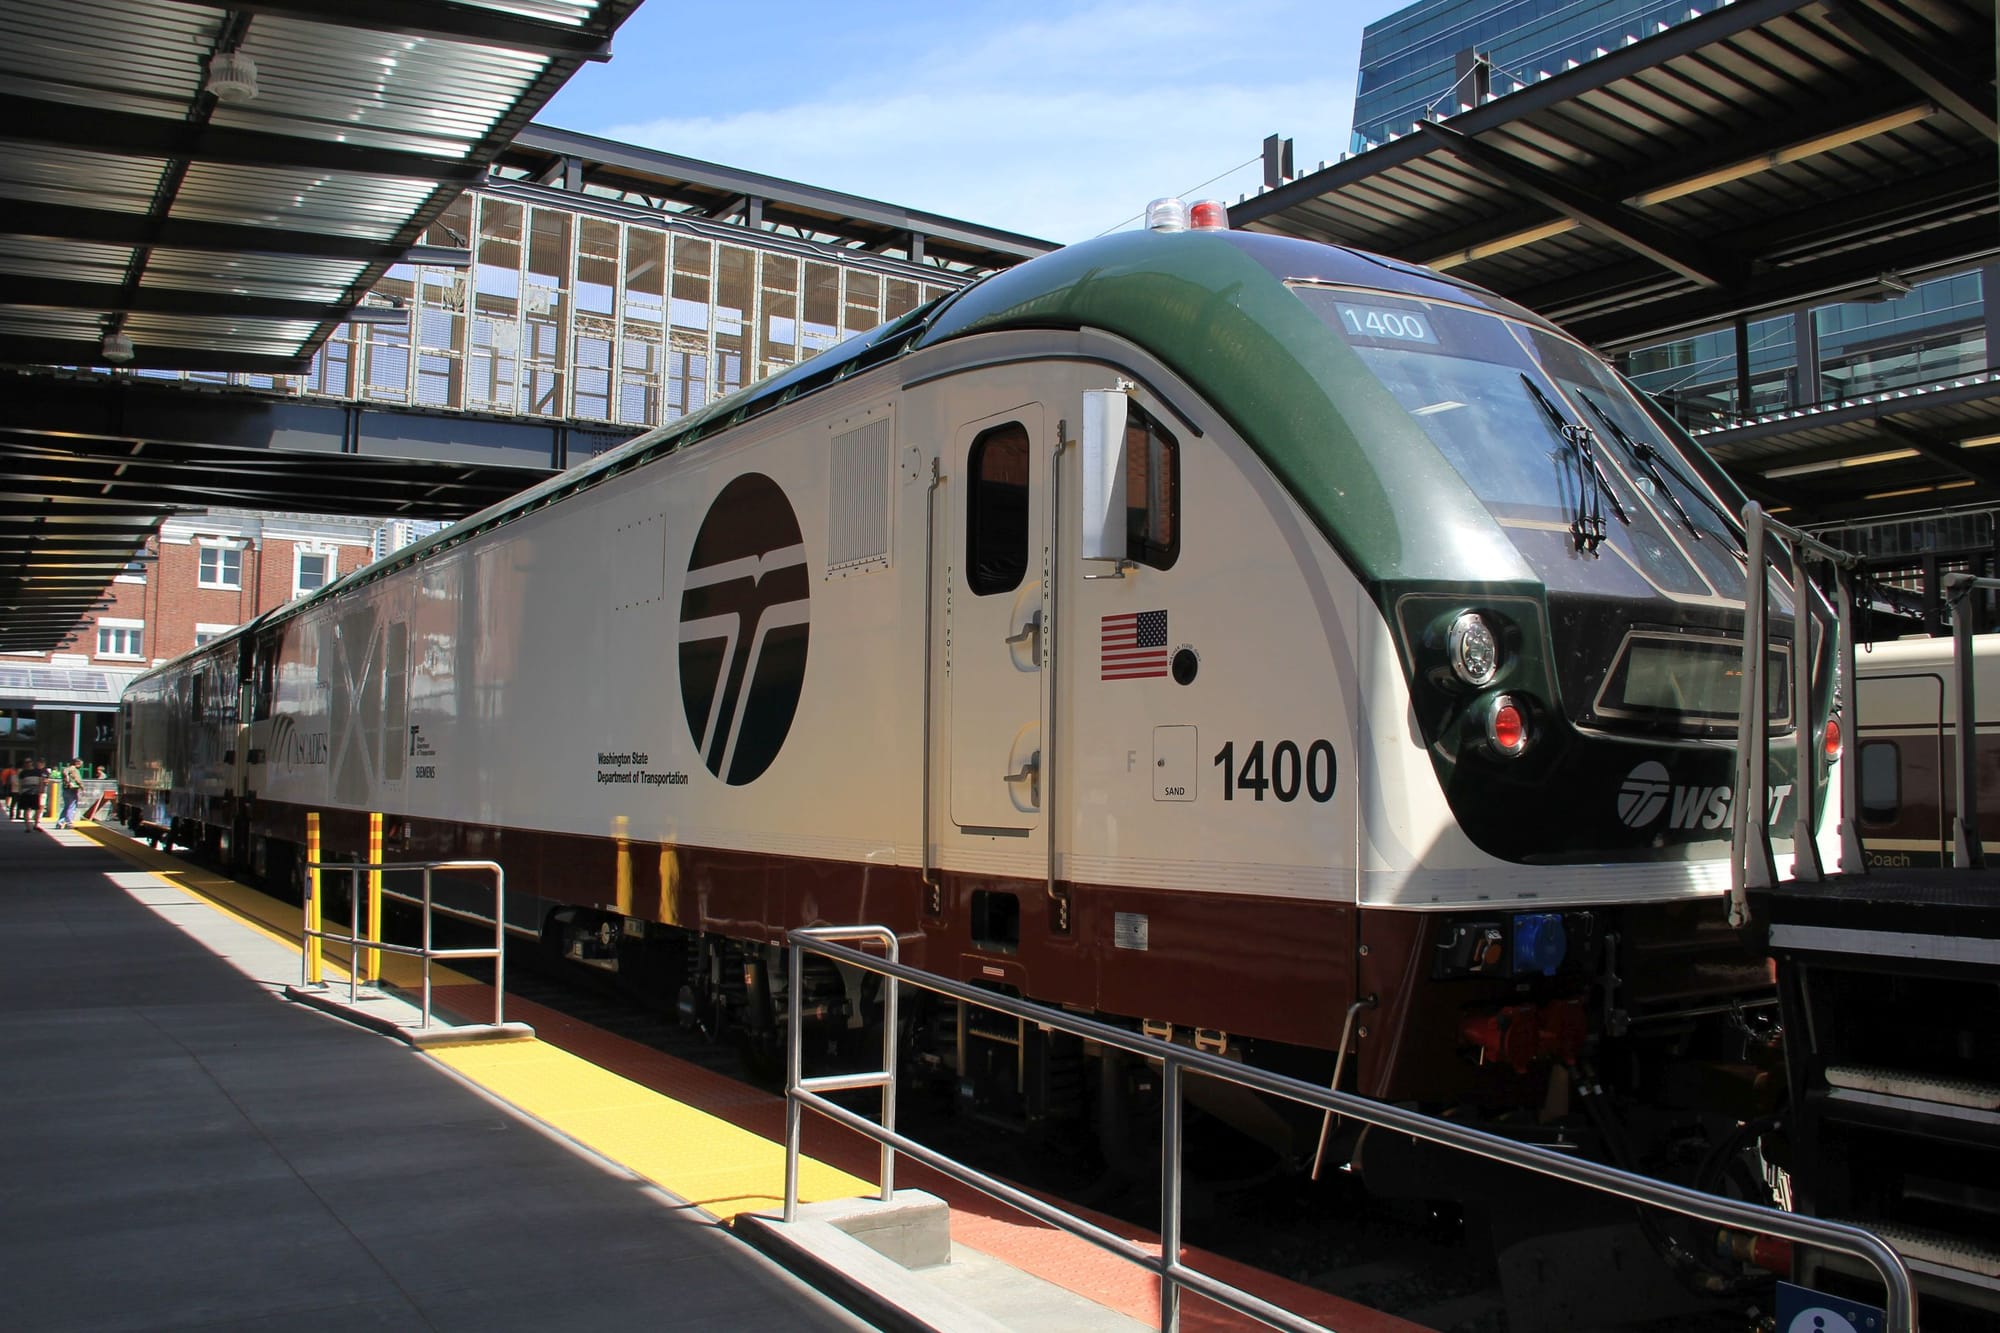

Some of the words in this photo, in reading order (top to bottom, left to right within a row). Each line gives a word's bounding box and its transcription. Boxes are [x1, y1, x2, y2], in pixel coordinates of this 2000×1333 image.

[1345, 309, 1424, 339] 1400
[597, 752, 631, 767] Washington
[632, 752, 648, 765] State
[1127, 750, 1137, 773] F
[1214, 739, 1337, 803] 1400
[597, 770, 632, 785] Department
[632, 771, 640, 783] of
[641, 771, 689, 787] Transportation
[1164, 786, 1185, 796] SAND
[1669, 784, 1792, 830] WST
